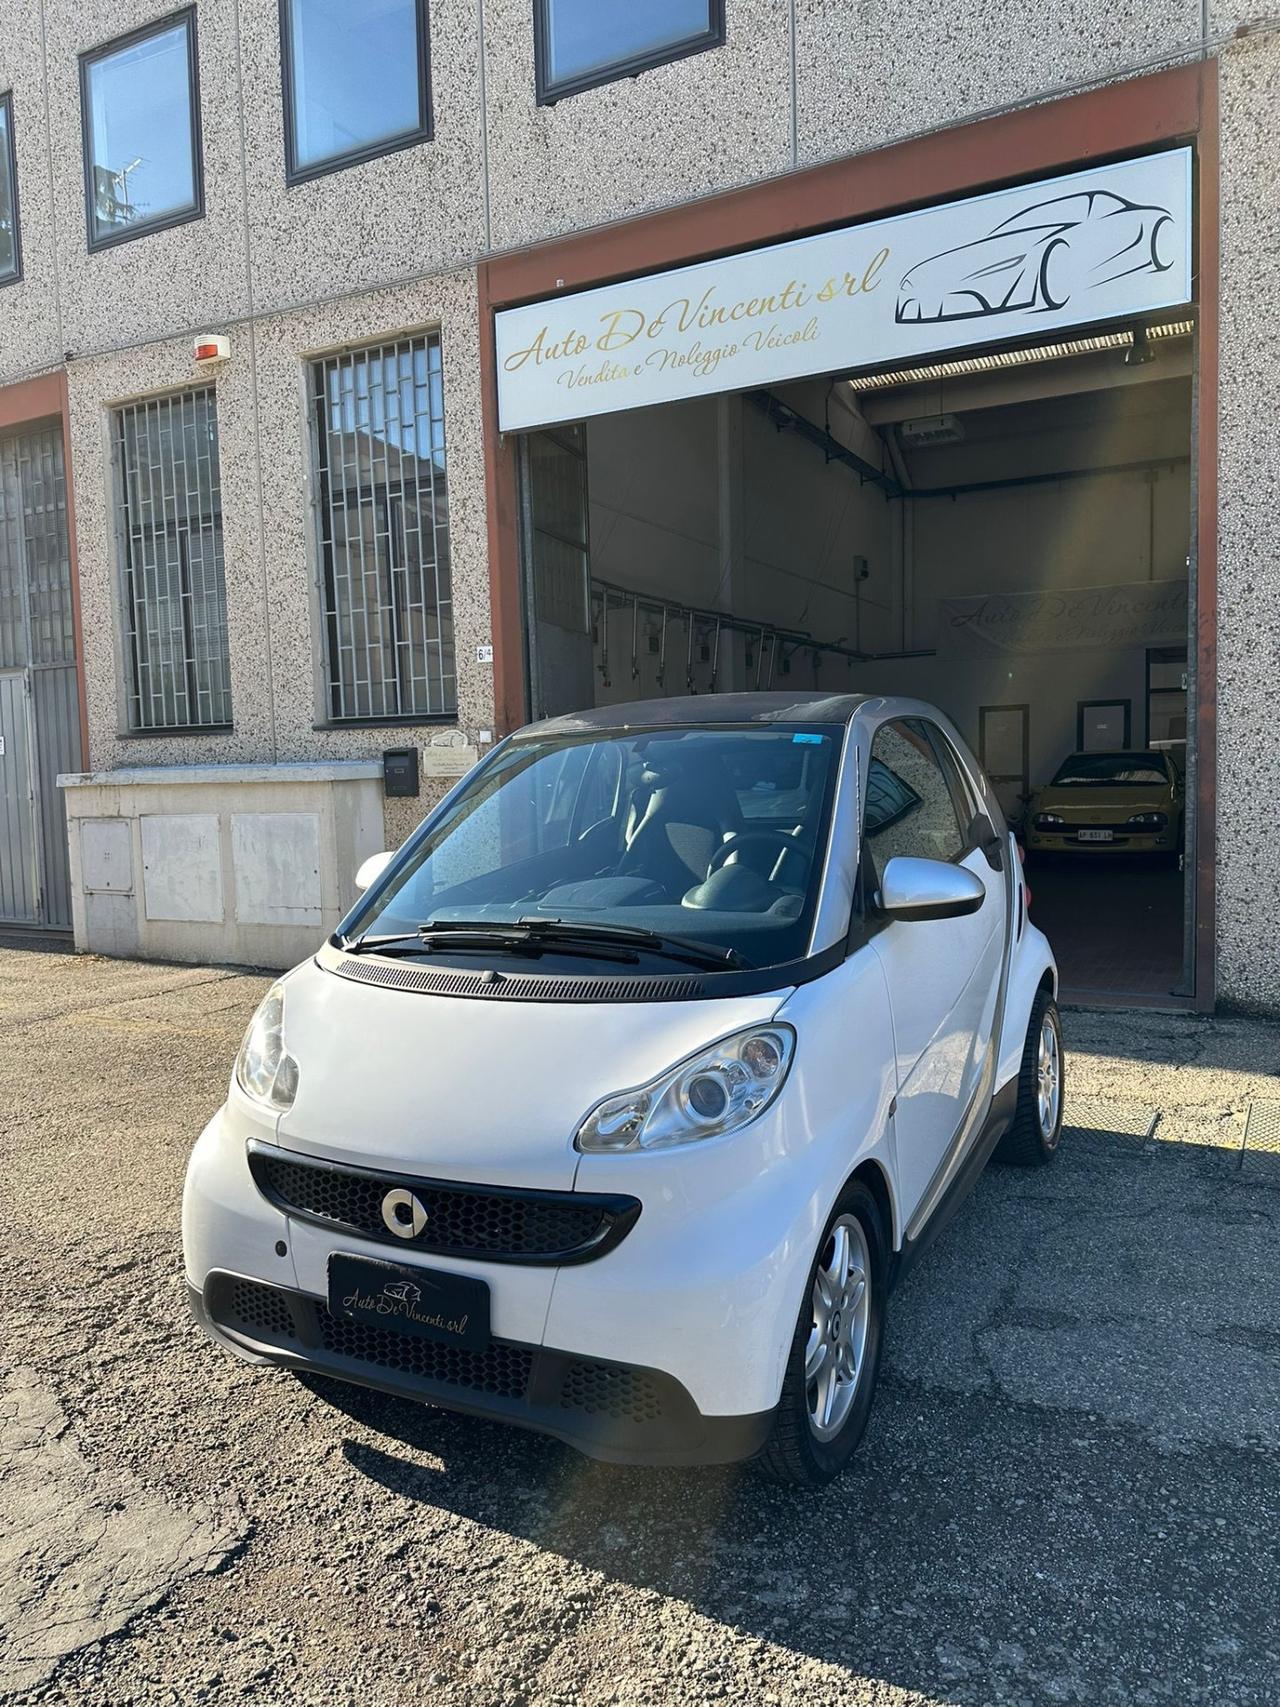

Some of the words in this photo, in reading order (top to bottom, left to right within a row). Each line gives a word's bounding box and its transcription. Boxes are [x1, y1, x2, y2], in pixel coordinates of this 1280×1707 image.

[504, 326, 591, 372] Auto
[659, 280, 812, 332] Vincenti
[817, 248, 890, 302] srl
[557, 360, 629, 389] Vendita
[633, 364, 645, 377] e
[645, 341, 739, 378] Noleggio
[742, 316, 821, 352] Veicoli
[343, 1288, 376, 1310] Auto
[398, 1300, 446, 1328] Vincenti
[447, 1314, 468, 1336] srl
